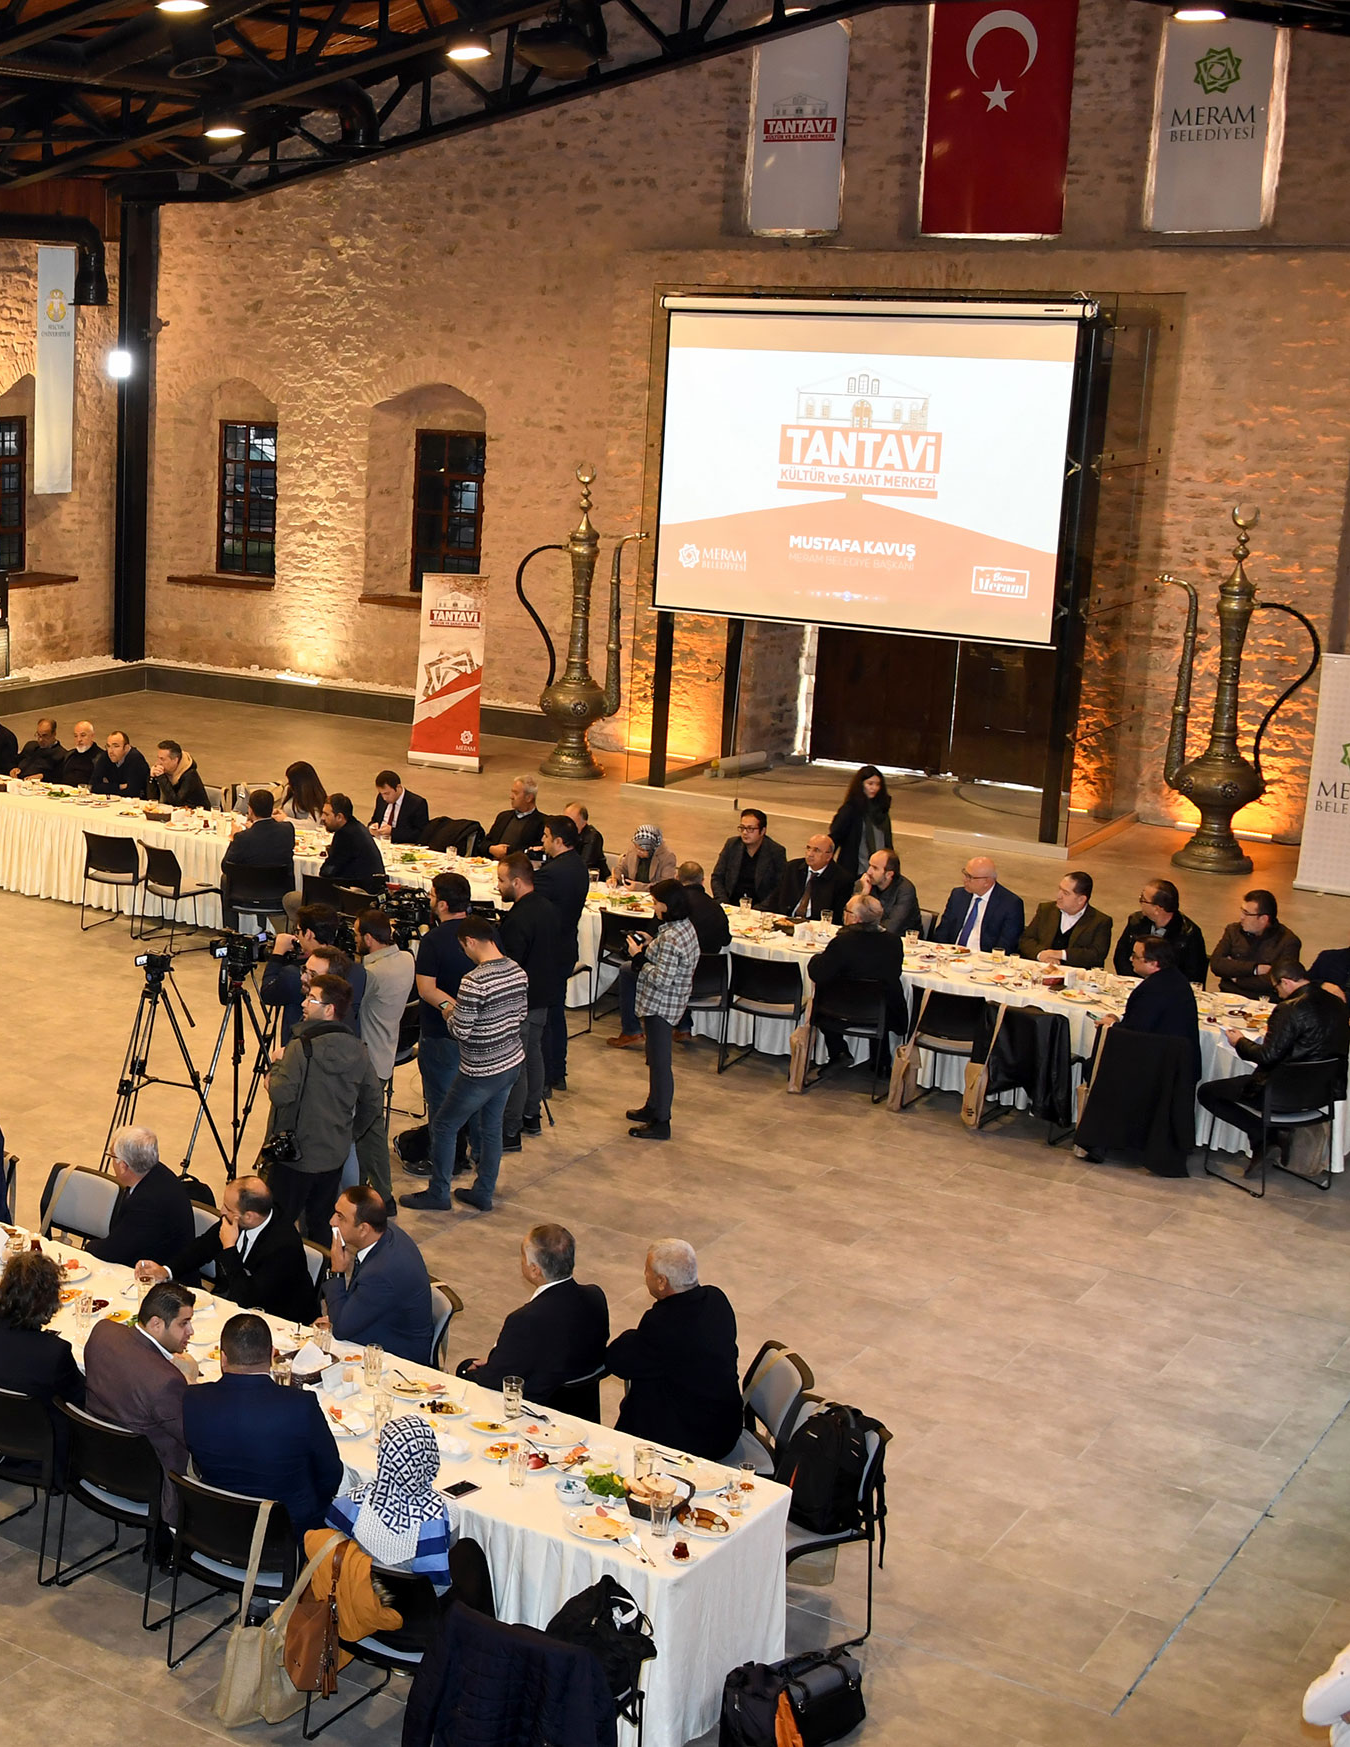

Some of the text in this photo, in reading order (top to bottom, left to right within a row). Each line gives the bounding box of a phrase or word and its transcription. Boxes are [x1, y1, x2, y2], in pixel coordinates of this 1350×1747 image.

[1170, 105, 1256, 127] MERAM
[1170, 124, 1255, 142] BELEDİYESİ
[780, 466, 937, 489] KÜLTÜR ve SANAT MERKEZİ
[702, 547, 747, 562] MERAM
[788, 535, 916, 562] MUSTAFA KAVUŞ
[788, 552, 824, 564] MERAM
